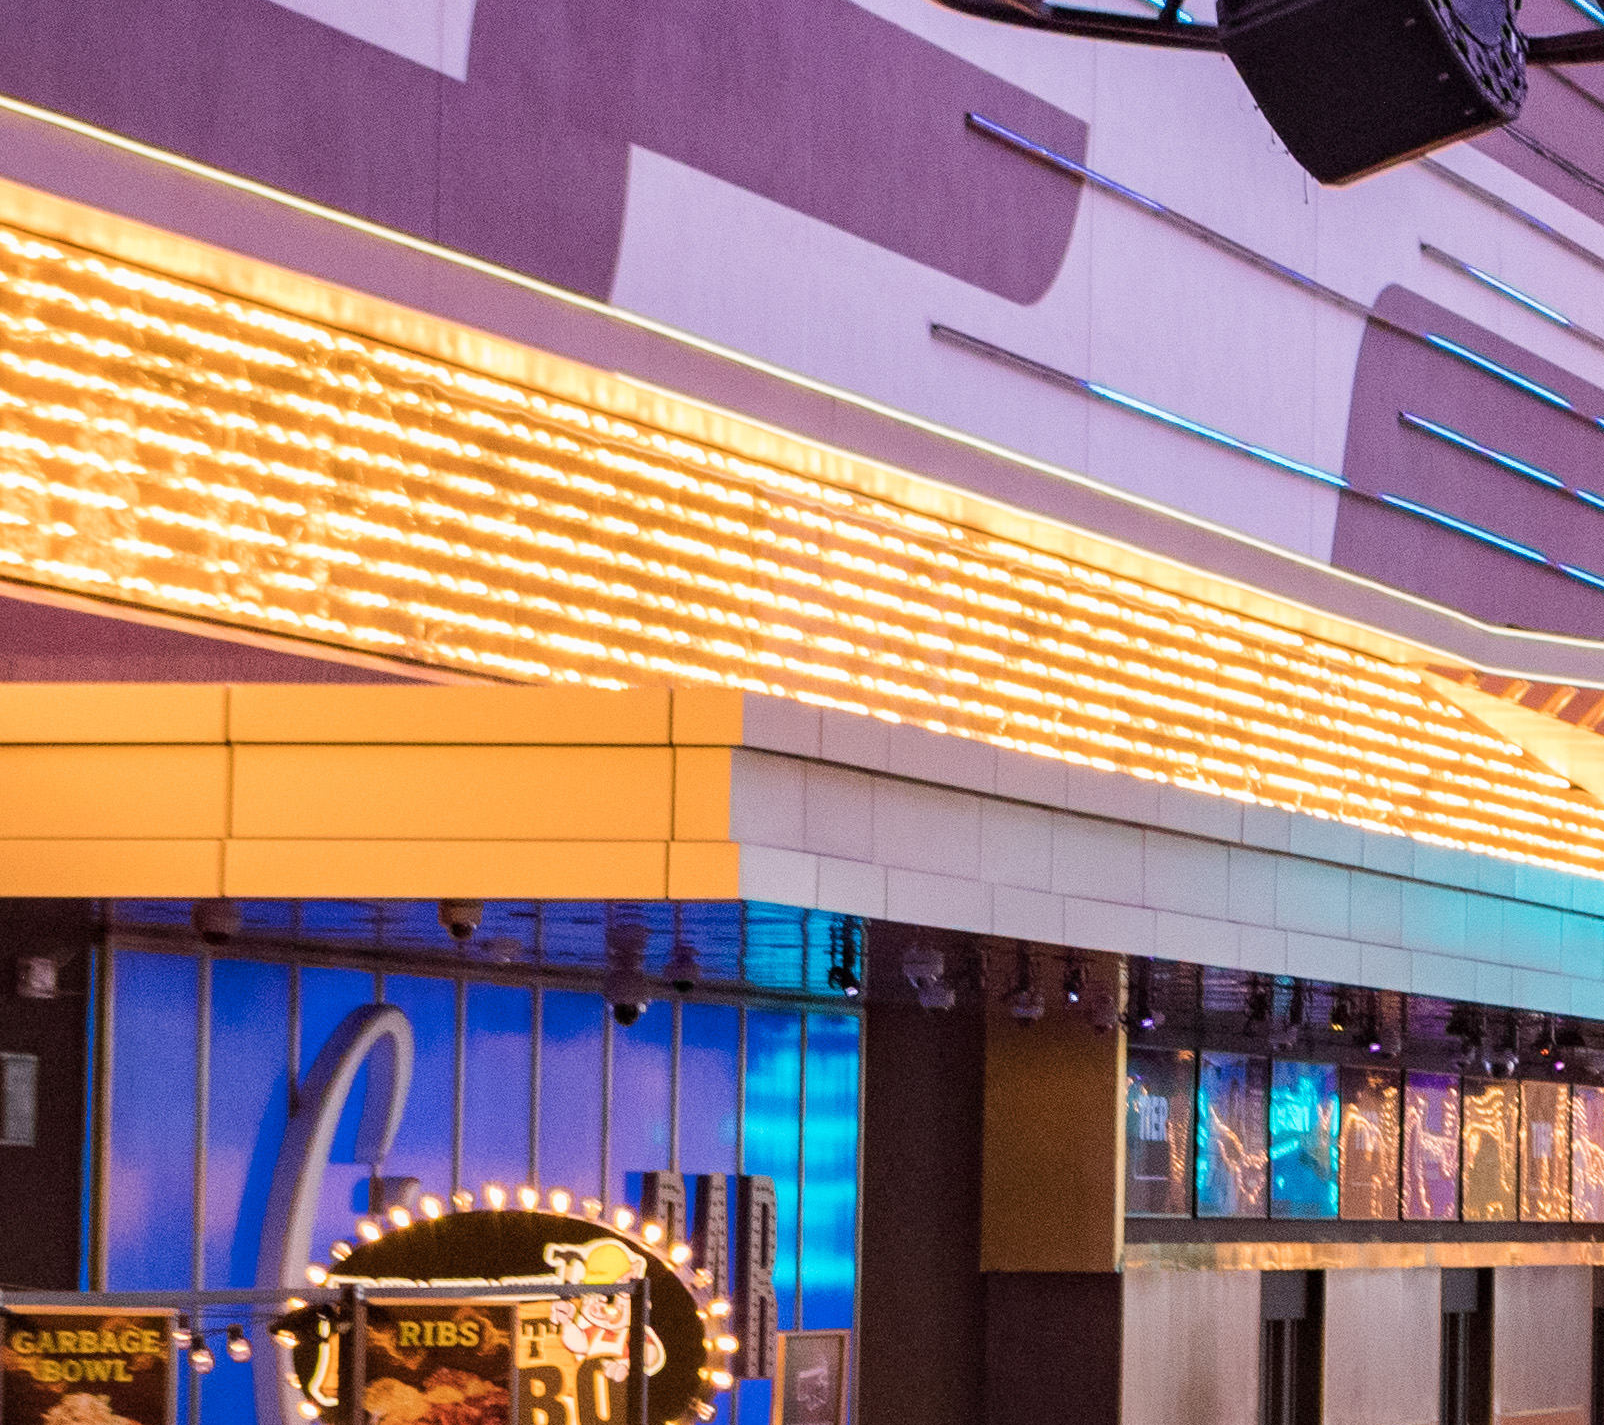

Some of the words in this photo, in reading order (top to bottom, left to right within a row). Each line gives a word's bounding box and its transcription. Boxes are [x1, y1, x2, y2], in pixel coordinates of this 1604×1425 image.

[11, 1327, 162, 1356] GARBAGE
[398, 1320, 480, 1348] RIBS
[33, 1359, 134, 1383] BOWL
